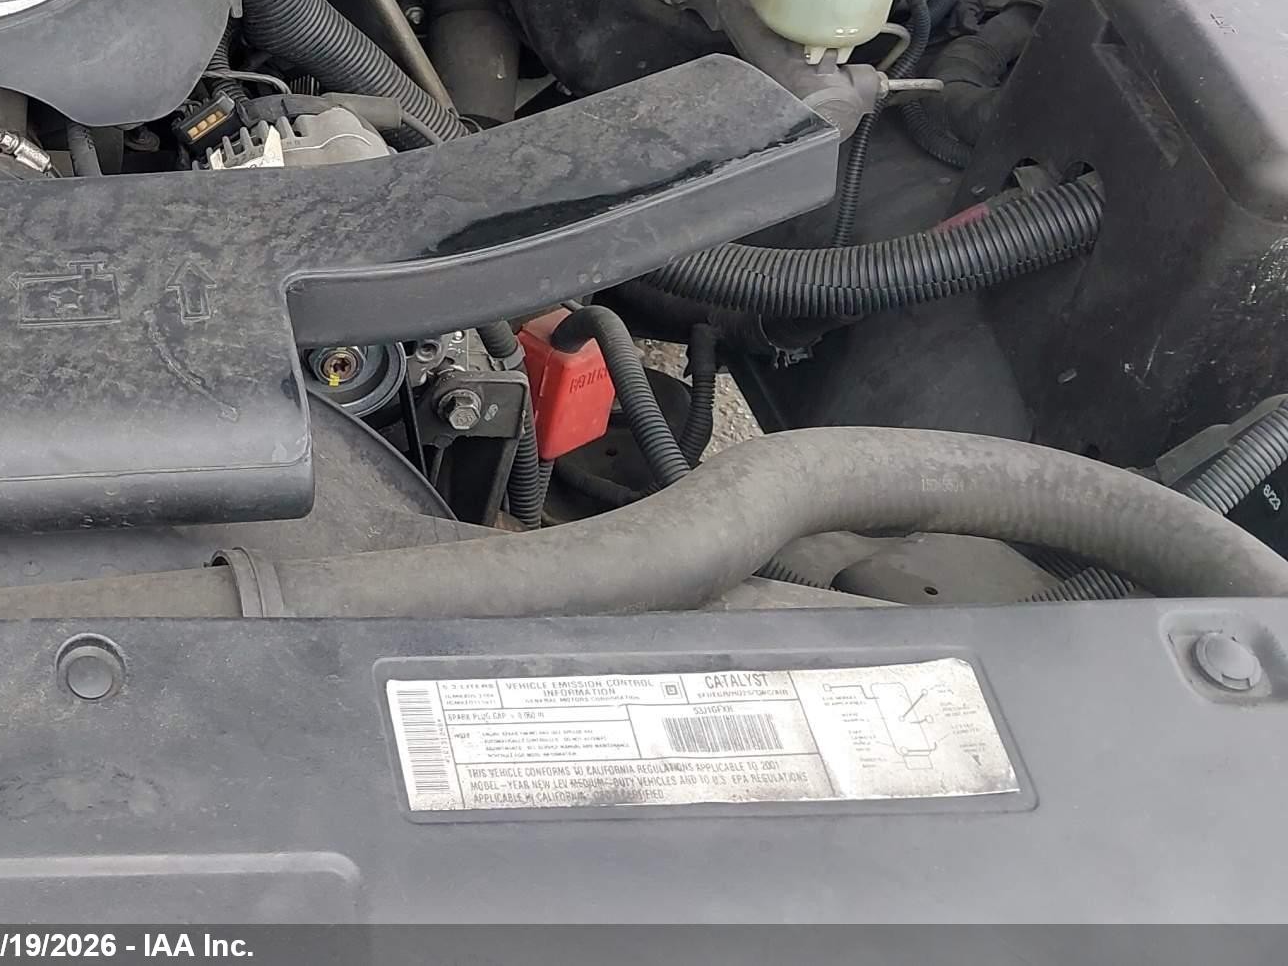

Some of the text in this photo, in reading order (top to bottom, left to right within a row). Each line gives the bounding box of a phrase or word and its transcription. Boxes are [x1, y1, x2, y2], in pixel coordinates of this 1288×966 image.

[505, 678, 655, 690] VEHICLE EMISSION CONTROL
[705, 673, 768, 689] CATALYST
[543, 687, 616, 697] INFORMATION
[468, 768, 487, 778] THIS
[489, 767, 523, 778] VEHICLE
[525, 766, 571, 777] CONFORMS
[574, 766, 584, 776] TO
[586, 765, 634, 776] CALIFORNIA
[636, 762, 694, 774] REGULATIONS
[696, 761, 744, 772] APPLICABLE
[747, 761, 758, 771] TO
[532, 779, 551, 790] NEW
[554, 778, 568, 789] LEV
[638, 775, 677, 786] VEHICLES
[679, 775, 697, 785] AND
[699, 775, 710, 784] TO
[732, 774, 749, 784] EPA
[751, 771, 809, 783] REGULATIONS
[473, 792, 525, 803] APPLICABLE
